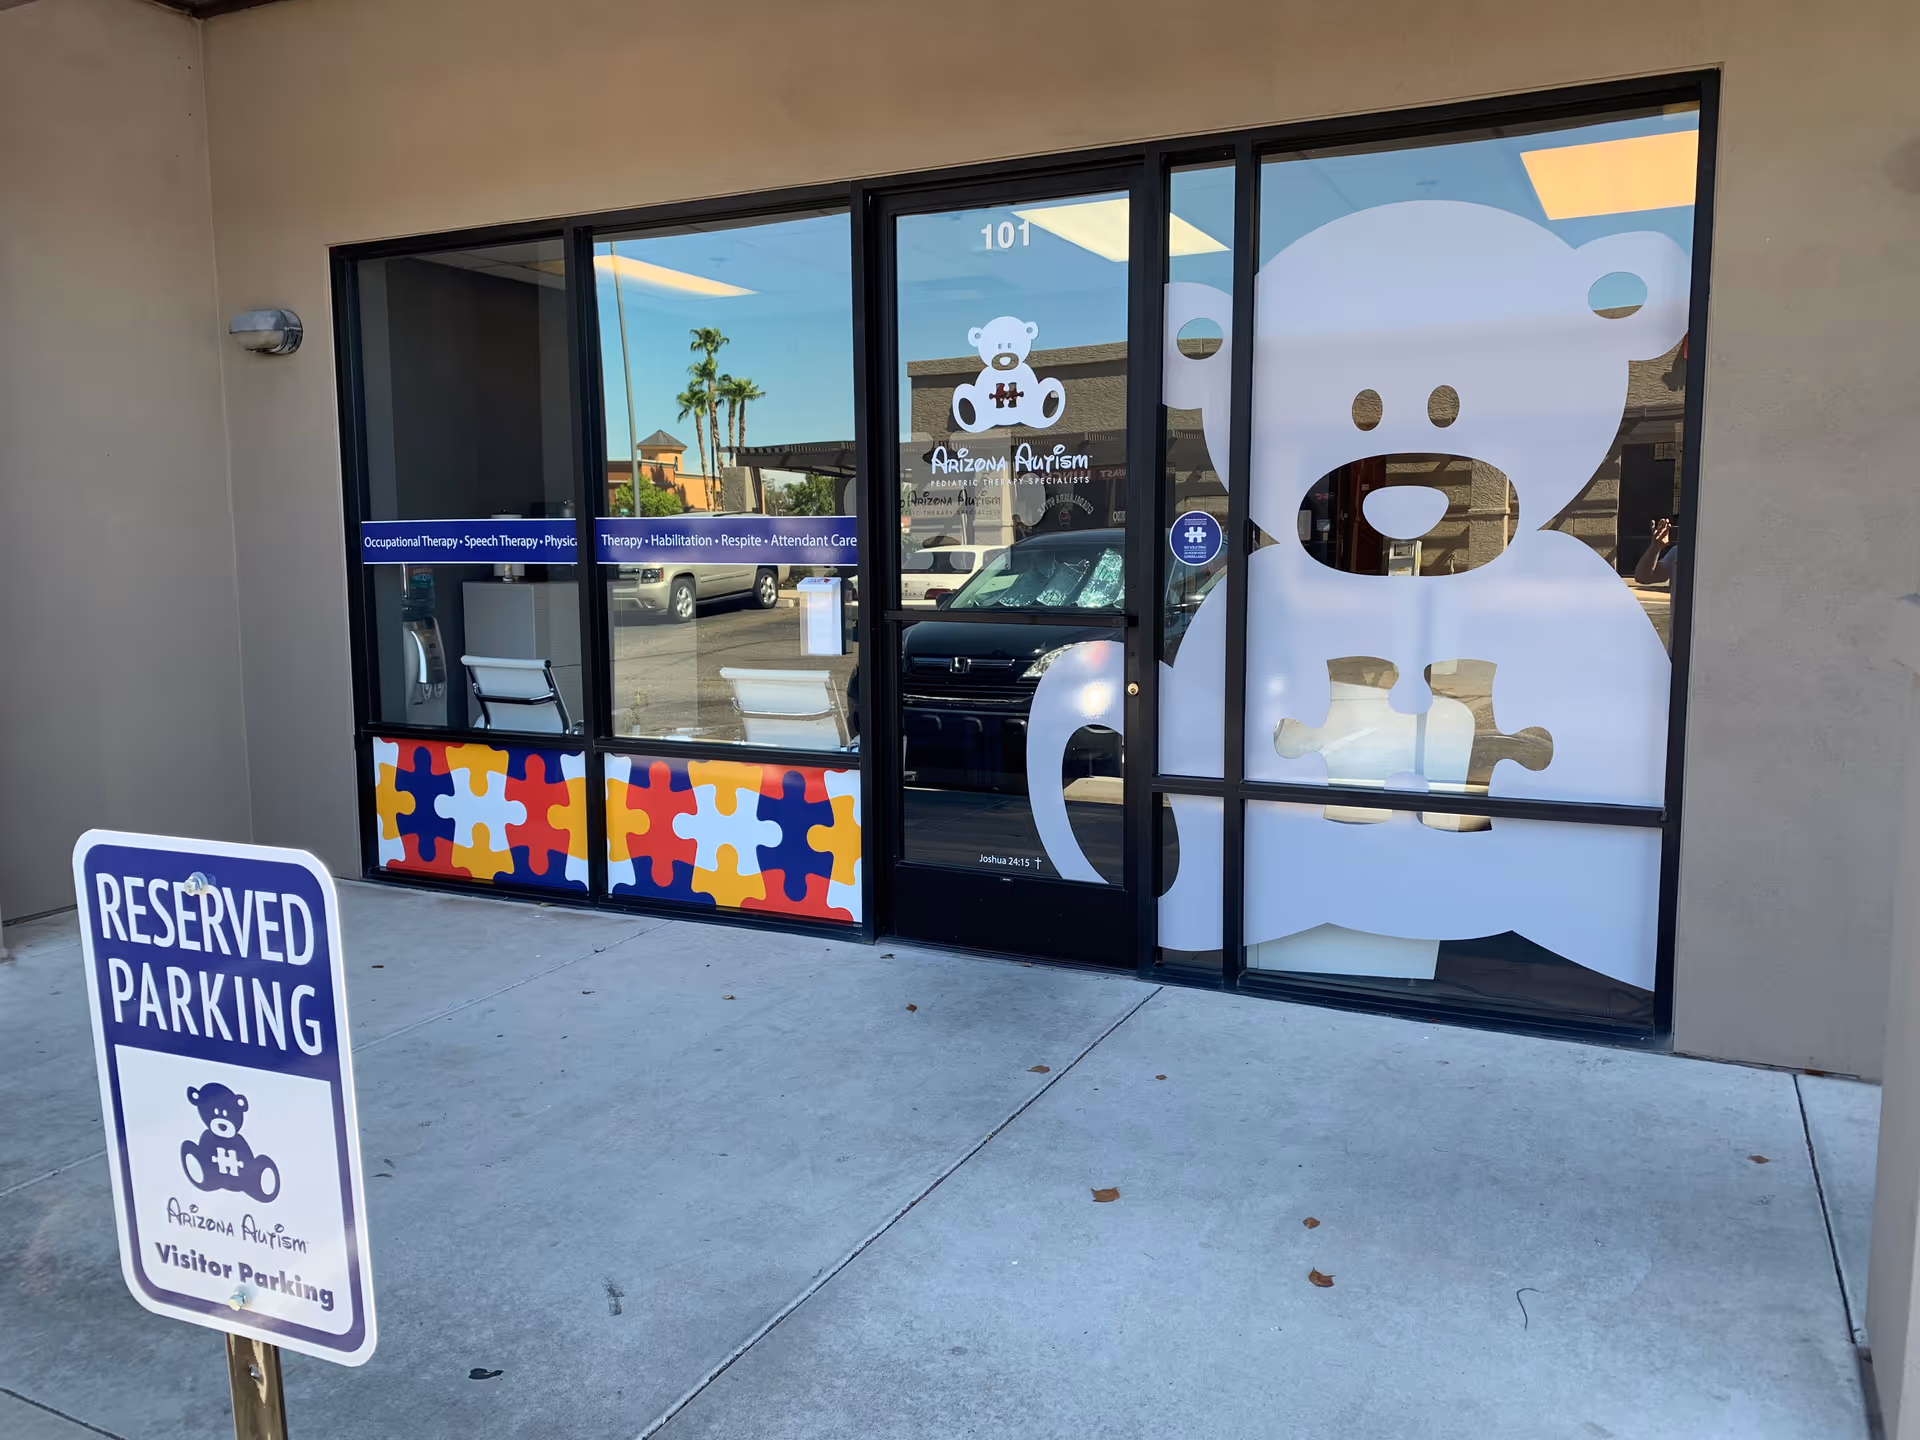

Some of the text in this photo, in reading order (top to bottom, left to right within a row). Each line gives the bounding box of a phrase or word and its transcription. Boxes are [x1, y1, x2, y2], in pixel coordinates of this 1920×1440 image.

[981, 220, 1030, 250] 101
[930, 476, 1090, 488] PEDIATRIC THERAPY SPECIALISTS
[364, 536, 421, 549] Occupational
[421, 535, 458, 549] Therapy
[464, 535, 498, 548] Speech
[499, 535, 538, 549] Therapy
[601, 534, 642, 549] Therapy
[651, 533, 712, 547] Habilitation
[721, 534, 762, 548] Respite
[771, 533, 829, 547] Attendant
[831, 534, 858, 547] Care
[979, 854, 1030, 867] Joshua 24:15
[96, 873, 315, 966] RESERVED
[108, 958, 323, 1056] PARKING
[154, 1242, 335, 1312] Visitor Parking
